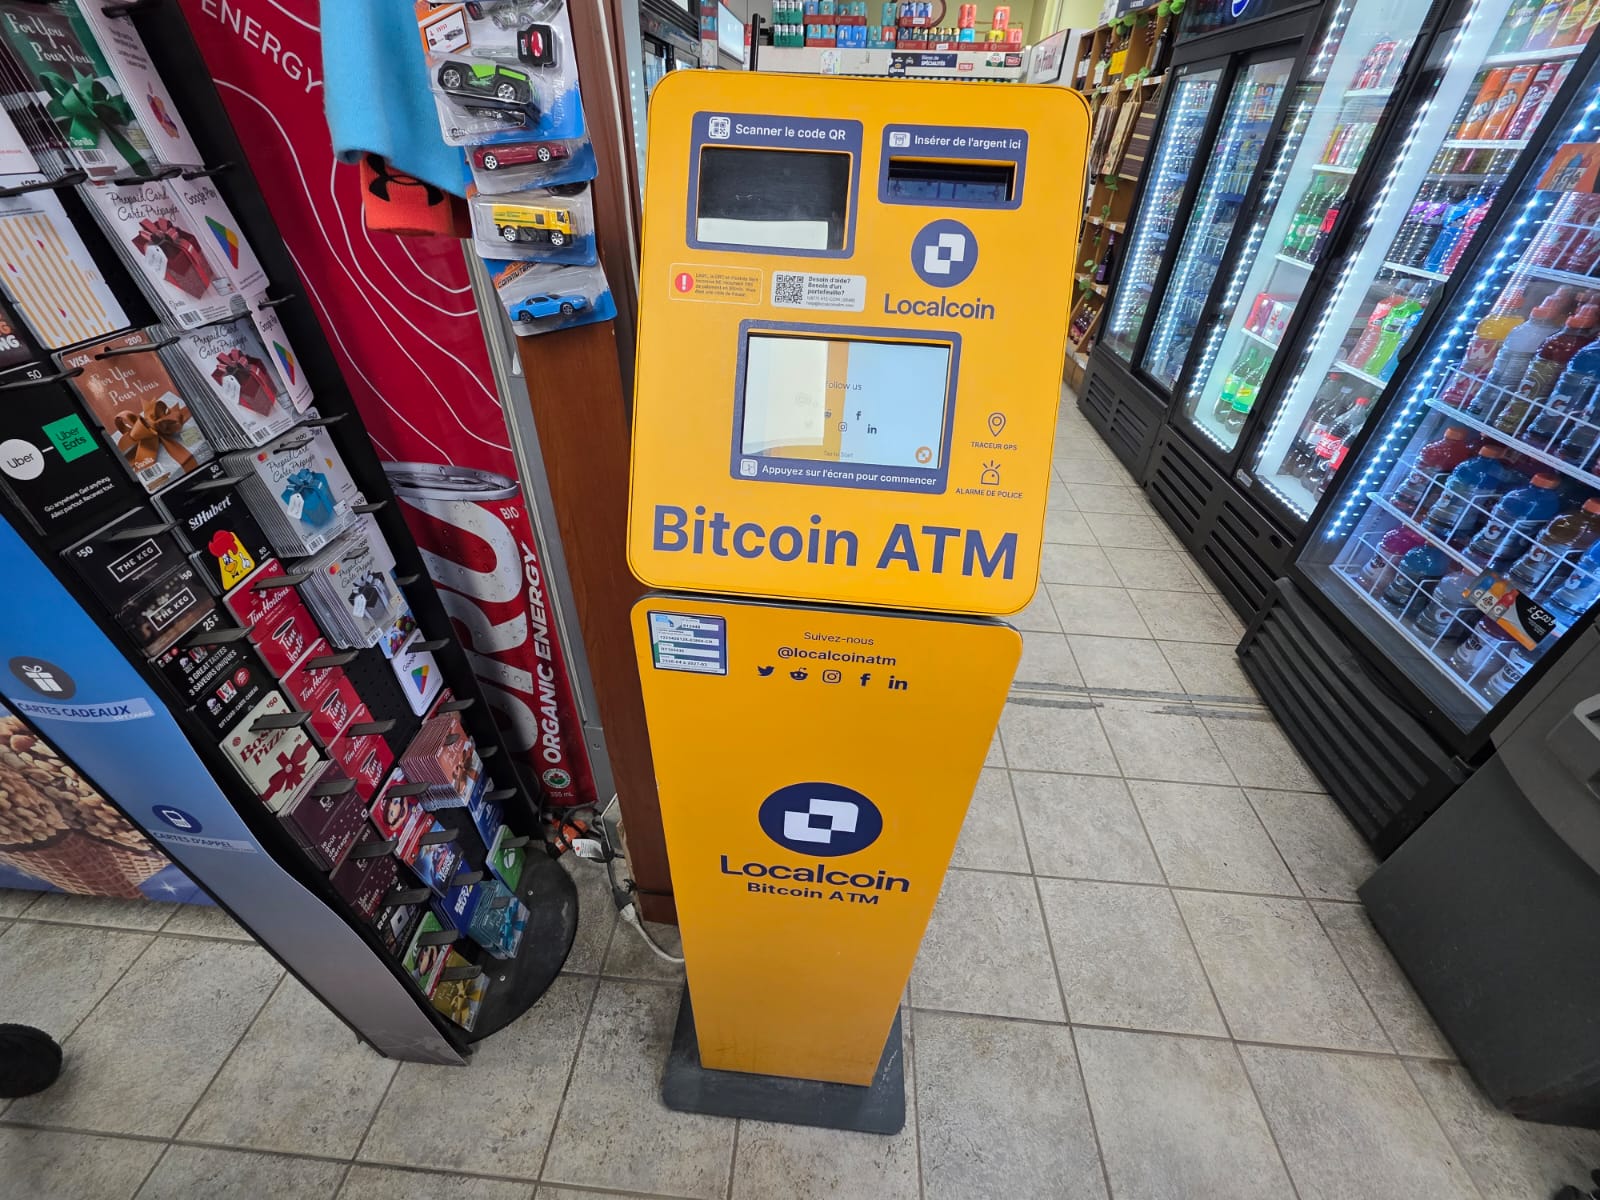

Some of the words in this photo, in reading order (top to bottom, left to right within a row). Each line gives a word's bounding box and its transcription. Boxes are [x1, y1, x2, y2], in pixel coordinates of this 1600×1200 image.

[200, 0, 323, 94] ENERGY
[735, 123, 782, 137] Scanner
[784, 126, 796, 137] le
[797, 127, 826, 139] code
[828, 129, 846, 140] QR
[914, 134, 951, 146] Insérer
[952, 136, 967, 147] de
[968, 137, 1007, 150] l'argent
[884, 292, 996, 320] Localcoin
[68, 354, 92, 368] VISA
[26, 369, 42, 380] 50
[108, 366, 136, 389] You
[108, 389, 137, 407] Pour
[132, 379, 160, 394] Vous
[852, 383, 862, 391] us
[56, 426, 80, 442] Uber
[62, 434, 88, 451] Eats
[971, 441, 1002, 450] TRACEUR
[6, 452, 35, 469] Uber
[762, 464, 804, 477] Appuyez
[805, 469, 821, 478] sur
[822, 469, 855, 481] l'écran
[855, 472, 878, 483] pour
[880, 474, 937, 486] commencer
[955, 487, 985, 496] ALARME
[986, 489, 996, 497] DE
[997, 491, 1023, 499] POLICE
[500, 507, 519, 520] BIO
[653, 504, 859, 567] Bitcoin
[875, 523, 1019, 581] ATM
[116, 557, 136, 573] THE
[135, 546, 154, 560] KEG
[156, 607, 173, 622] THE
[172, 594, 189, 608] KEG
[246, 609, 264, 625] Tim
[259, 586, 289, 613] Hortons
[521, 543, 552, 662] ENERGY
[278, 628, 298, 649] Tim
[803, 631, 875, 646] Suivez-nous
[188, 676, 195, 684] 3
[192, 661, 211, 681] GREAT
[208, 646, 228, 667] TASTES
[777, 646, 897, 667] @localcoinatm
[193, 668, 218, 692] SAVEURS
[214, 649, 238, 671] UNIQUES
[298, 685, 314, 701] Tim
[17, 702, 61, 716] CARTES
[61, 705, 131, 718] CADEAUX
[325, 700, 341, 718] Tim
[537, 663, 560, 764] ORGANIC
[365, 759, 377, 777] Tim
[152, 832, 187, 844] CARTES
[191, 836, 233, 848] D'APPEL
[720, 854, 910, 893] Localcoin
[747, 881, 823, 899] Bitcoin
[829, 891, 880, 905] ATM
